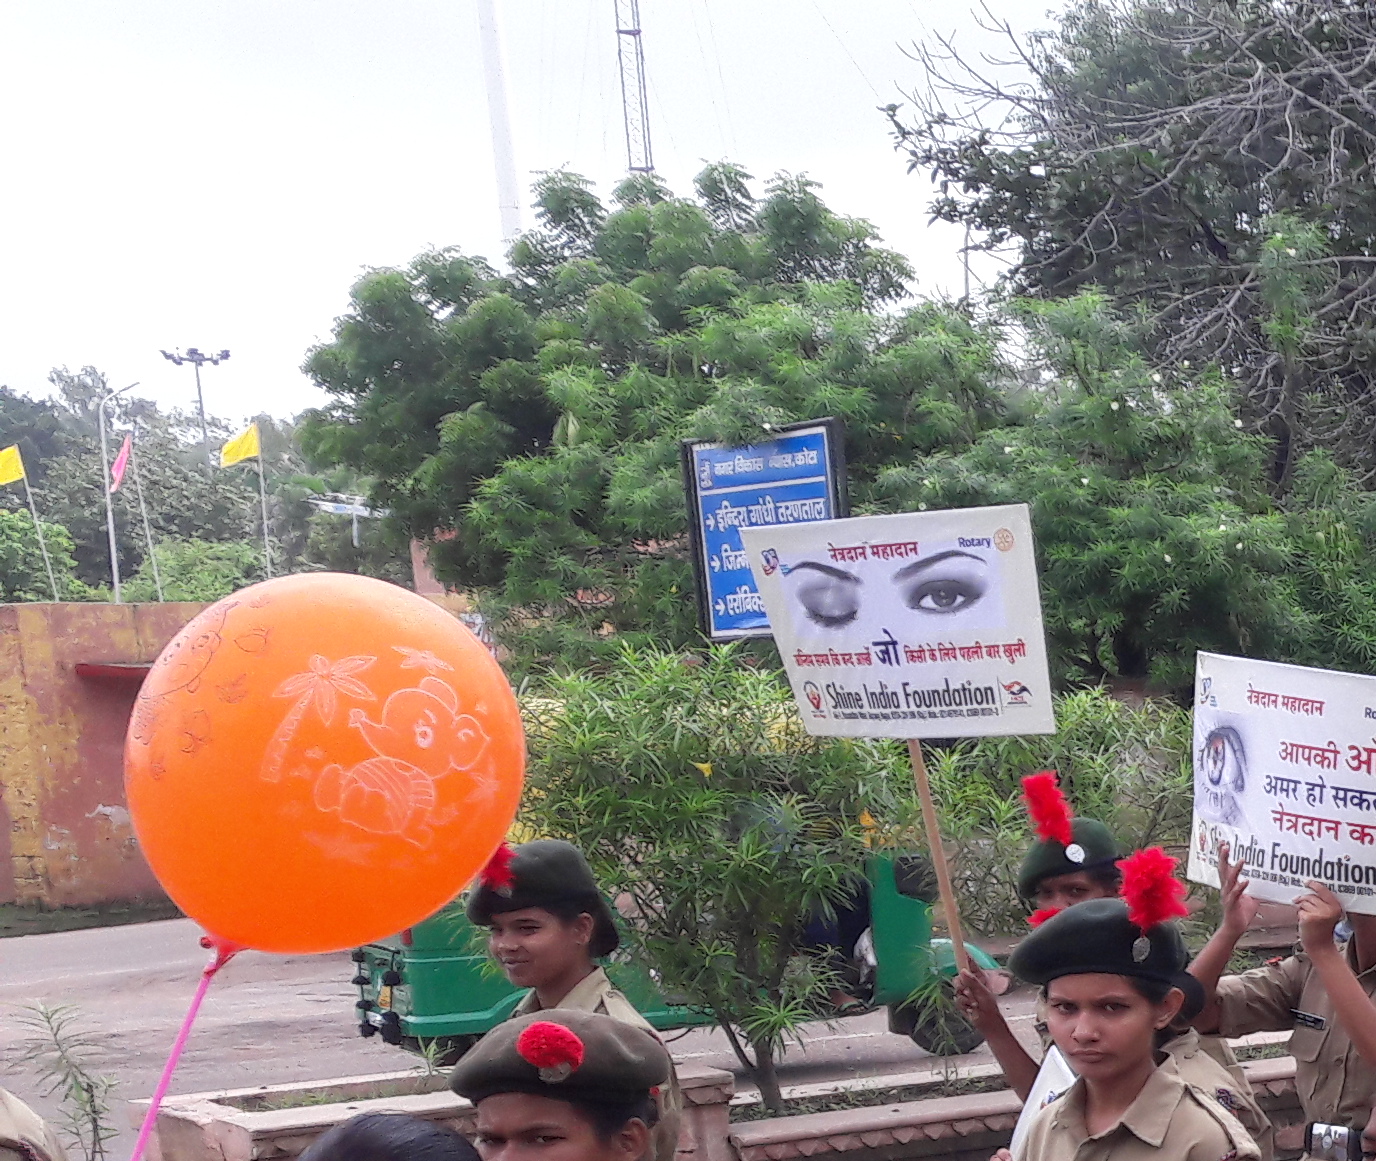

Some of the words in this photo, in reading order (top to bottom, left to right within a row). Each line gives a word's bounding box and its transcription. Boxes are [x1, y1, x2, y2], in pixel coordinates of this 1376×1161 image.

[827, 542, 867, 563] नेत्रदान
[869, 540, 918, 558] महादान
[958, 536, 991, 549] Rotary
[871, 628, 901, 667] जो
[826, 681, 863, 710] Shine
[864, 680, 900, 709] India
[901, 677, 996, 709] Foundation
[1247, 683, 1279, 709] नेत्रदान
[1281, 695, 1325, 717] महादान
[1279, 740, 1340, 771] आपकी
[1263, 774, 1301, 801] अमर
[1305, 775, 1326, 807] हो
[1271, 802, 1341, 842] नेत्रदान
[1234, 834, 1264, 868] India
